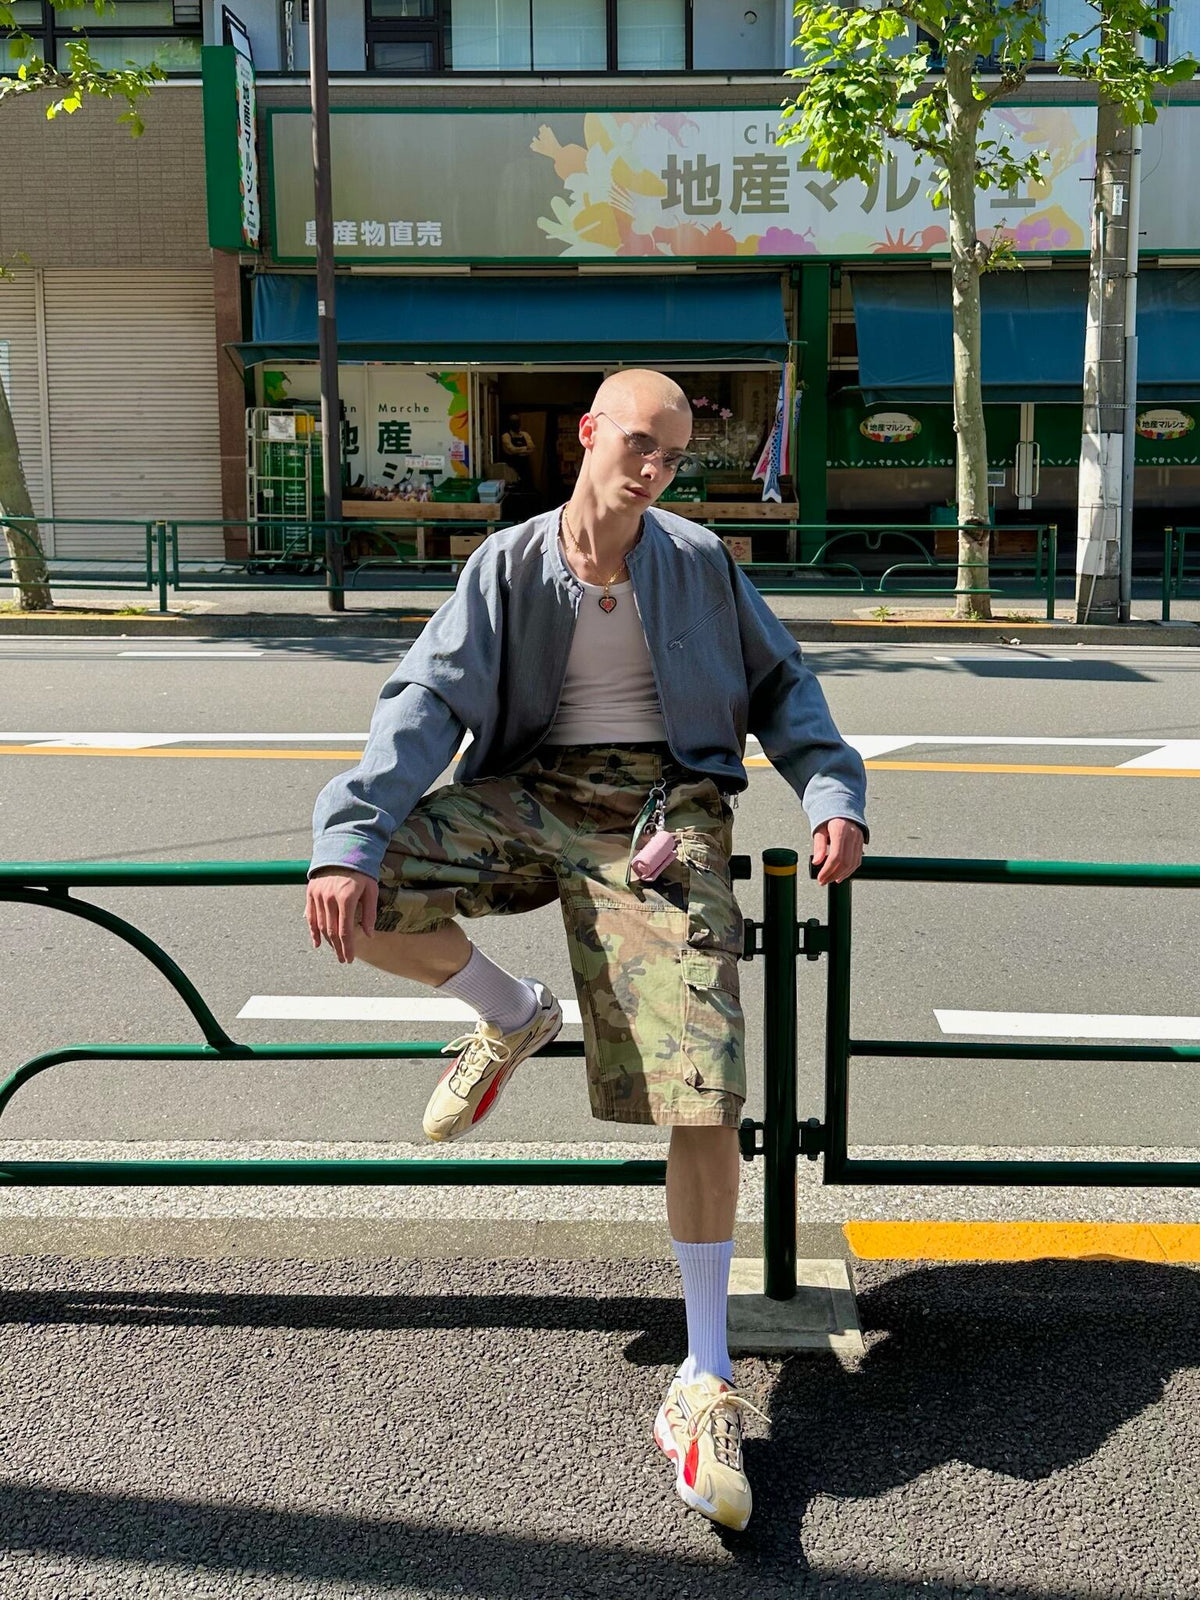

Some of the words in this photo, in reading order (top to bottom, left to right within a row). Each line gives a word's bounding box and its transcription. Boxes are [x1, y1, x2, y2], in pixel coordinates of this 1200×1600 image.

[378, 403, 430, 413] Marche
[869, 423, 913, 432] 地産マルシェ
